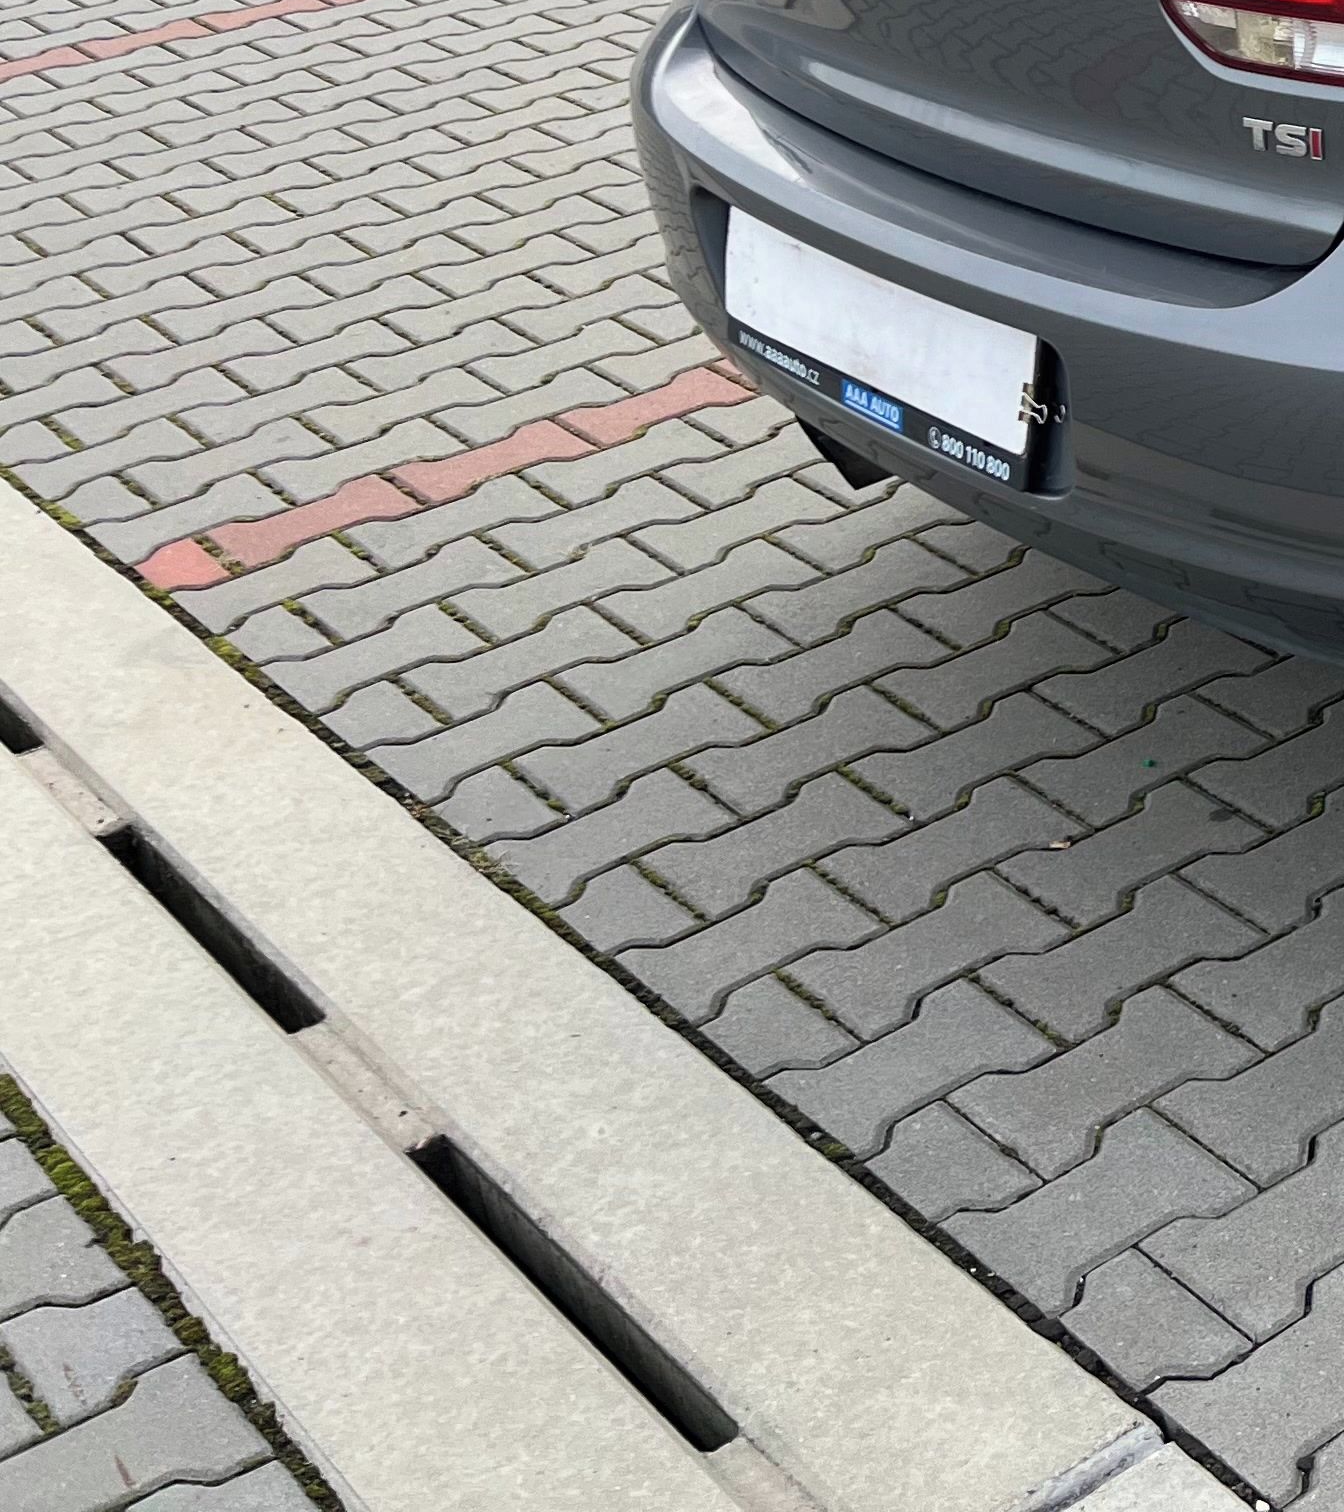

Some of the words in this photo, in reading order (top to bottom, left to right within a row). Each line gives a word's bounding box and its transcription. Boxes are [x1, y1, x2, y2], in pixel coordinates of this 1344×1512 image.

[1241, 116, 1324, 161] TSI
[845, 383, 868, 408] AAA
[869, 394, 900, 424] AUTO
[940, 433, 964, 460] 800
[985, 454, 1011, 481] 800
